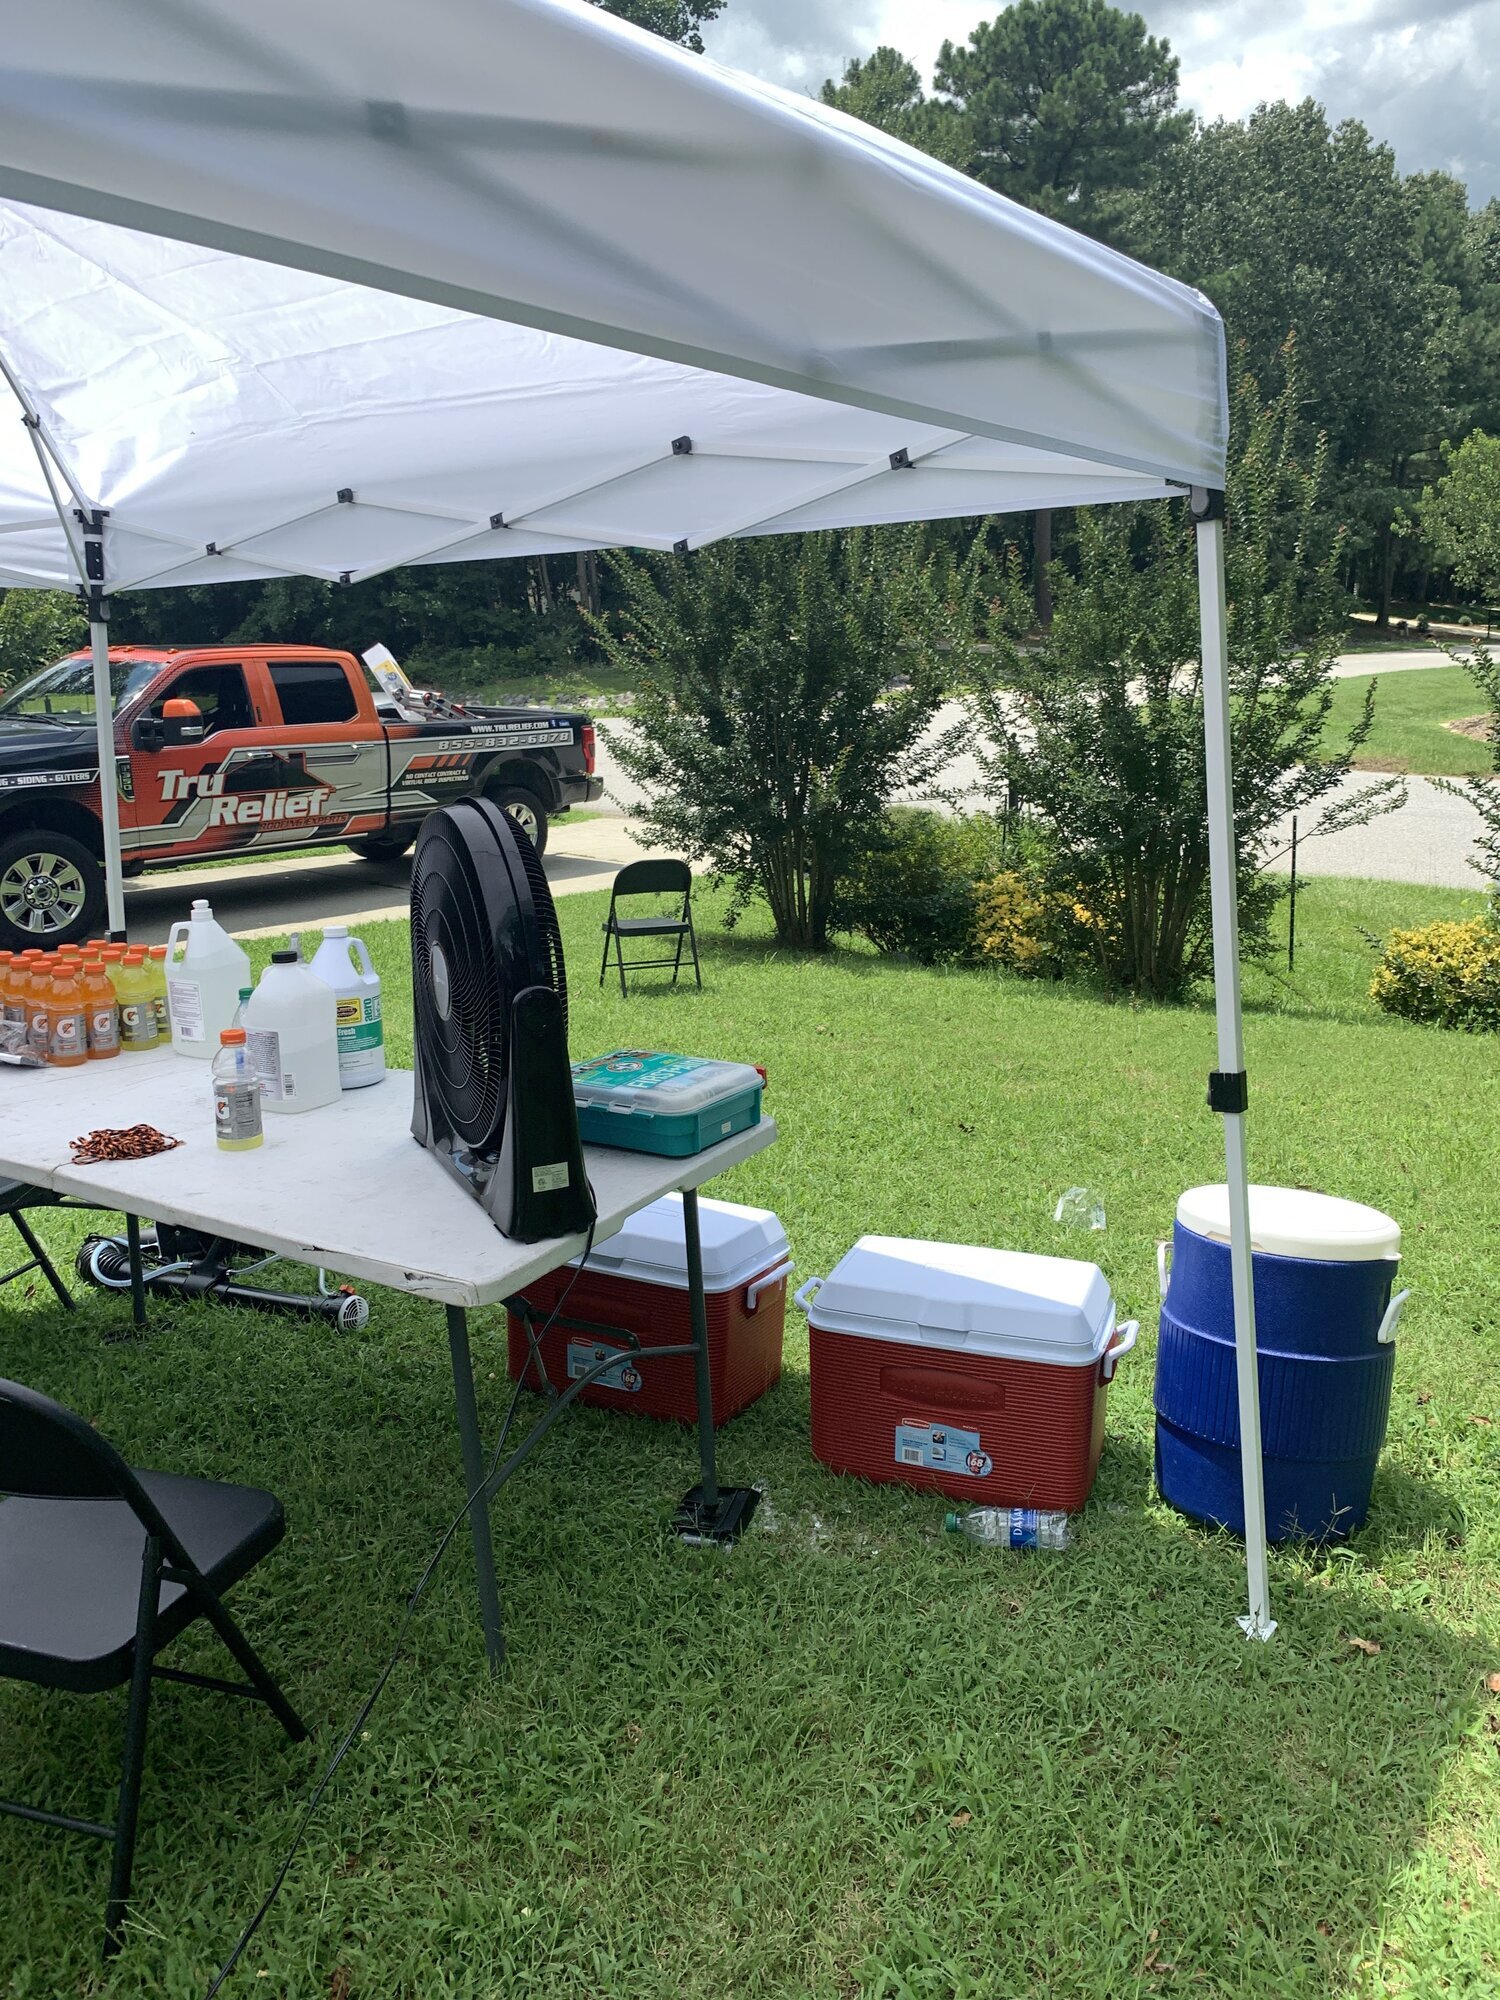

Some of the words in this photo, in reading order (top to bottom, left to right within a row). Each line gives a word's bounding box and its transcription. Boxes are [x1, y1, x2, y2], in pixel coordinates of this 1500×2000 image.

[471, 721, 549, 734] WWW.TRURELIEF.COM
[438, 732, 569, 750] 855-832-6878
[17, 775, 48, 785] SIDING
[55, 772, 90, 782] GUTTERS
[157, 769, 225, 800] Tru
[402, 778, 424, 786] VIRTUAL
[438, 775, 469, 783] INSPECTIONS
[209, 788, 330, 827] Relief
[261, 818, 305, 831] ROOFING
[304, 813, 349, 827] EXPERTS
[122, 1007, 140, 1026] G
[363, 998, 373, 1022] aero
[57, 1018, 75, 1038] G
[93, 1013, 110, 1032] G
[337, 1027, 356, 1036] Fresh
[627, 1067, 682, 1088] FIRST
[216, 1096, 230, 1120] G
[625, 1374, 636, 1383] 68
[970, 1458, 983, 1467] 68
[1012, 1508, 1025, 1536] DASA
